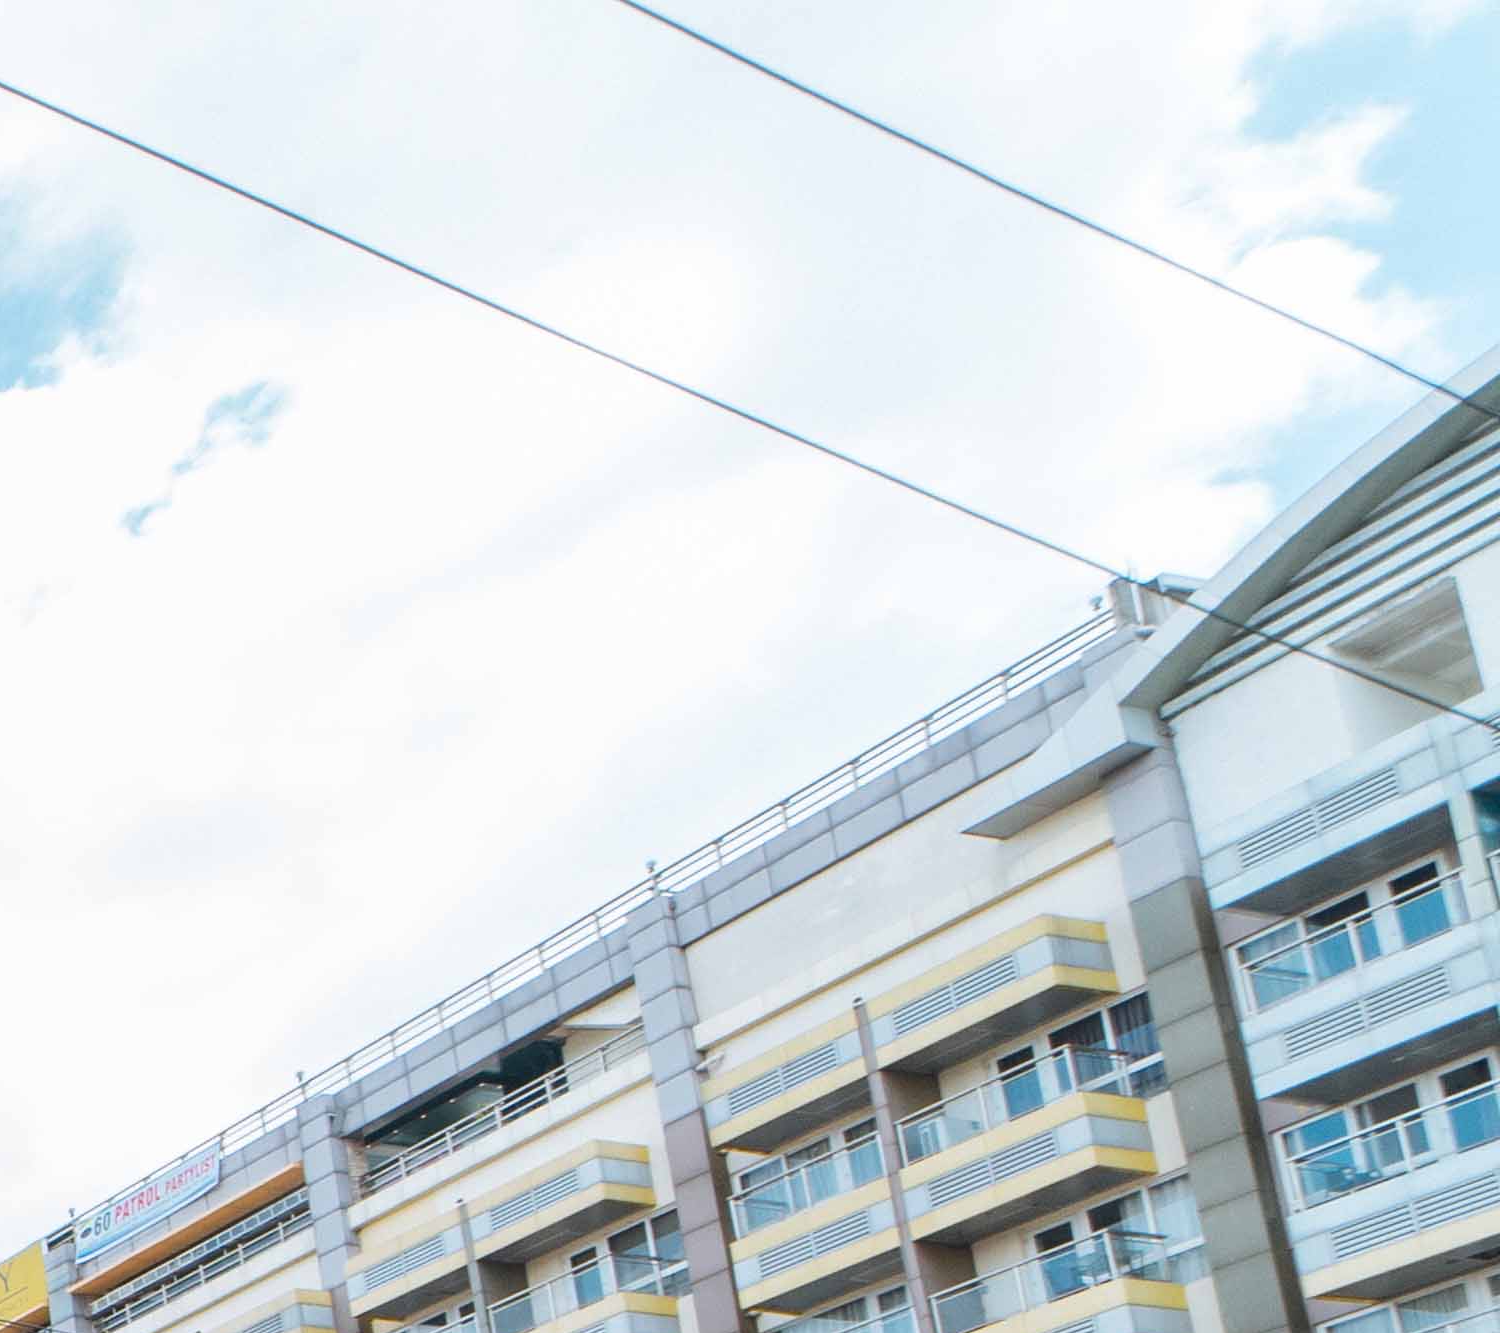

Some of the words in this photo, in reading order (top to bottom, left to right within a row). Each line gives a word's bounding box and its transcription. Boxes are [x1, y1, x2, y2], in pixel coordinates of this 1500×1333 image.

[94, 1213, 111, 1236] 60
[115, 1183, 160, 1224] PATROL
[165, 1153, 216, 1193] PARTYLIST
